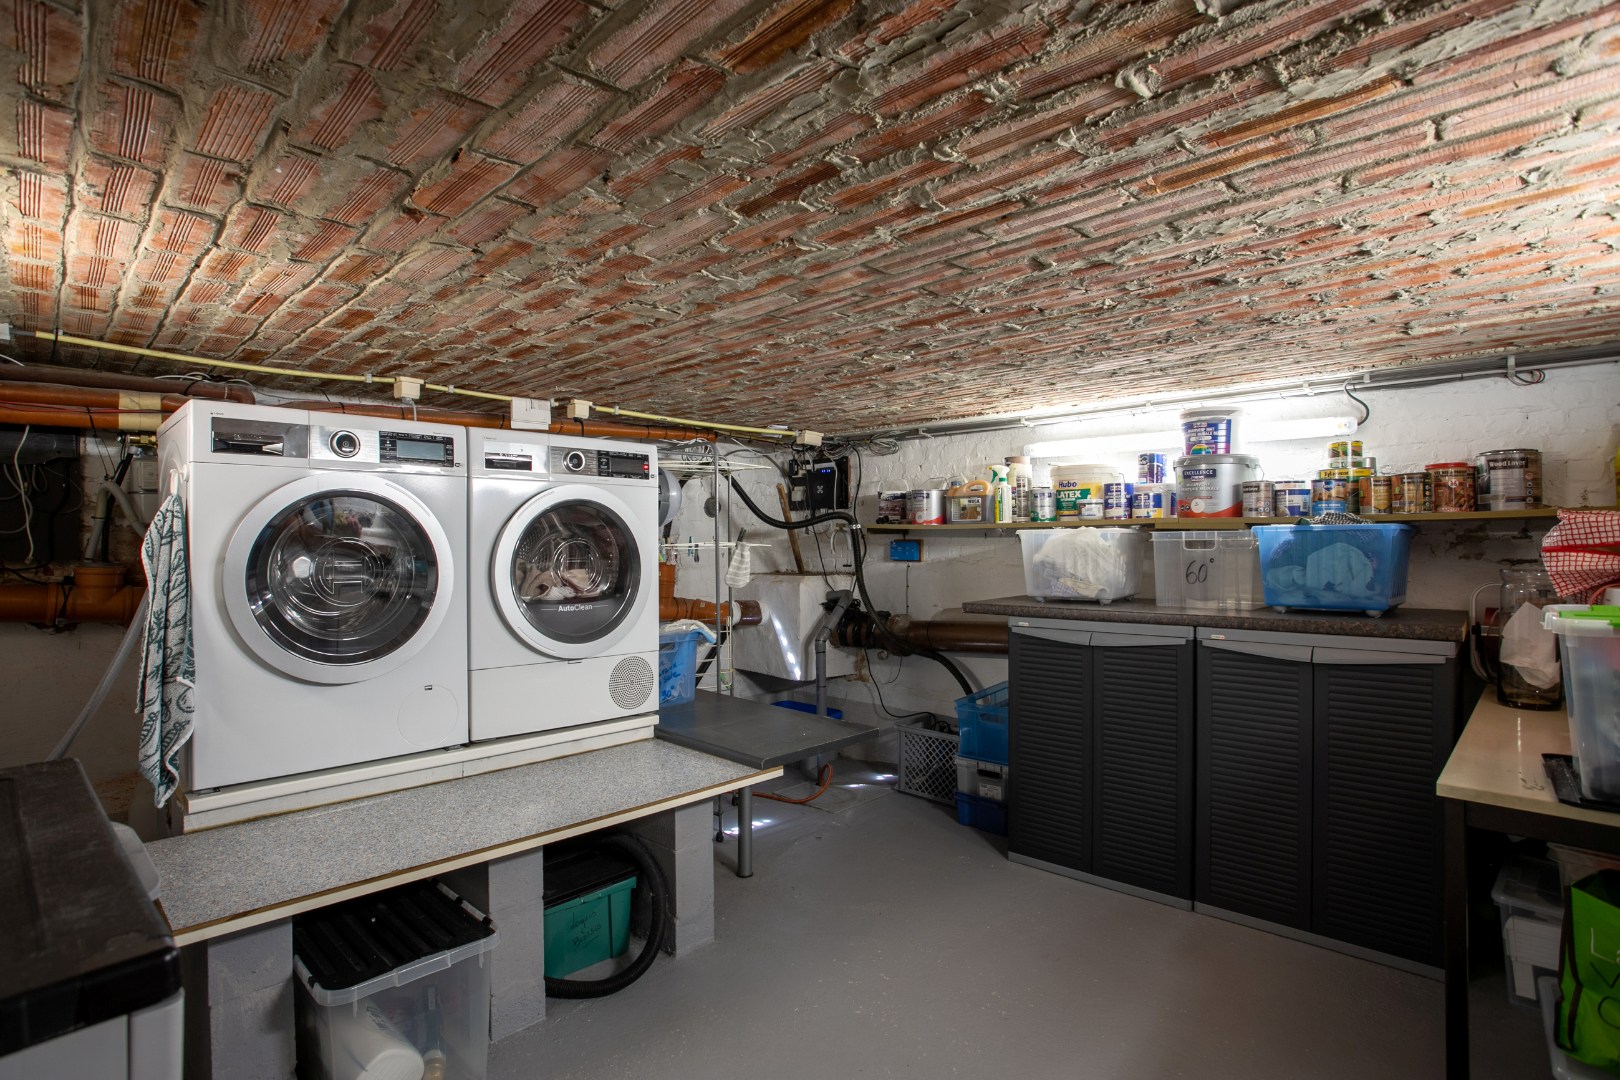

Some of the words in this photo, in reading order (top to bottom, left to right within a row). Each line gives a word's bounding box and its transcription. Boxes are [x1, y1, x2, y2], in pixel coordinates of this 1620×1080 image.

[1058, 480, 1078, 488] Hubo
[1057, 490, 1081, 499] LATEX
[558, 604, 593, 612] AutoClean
